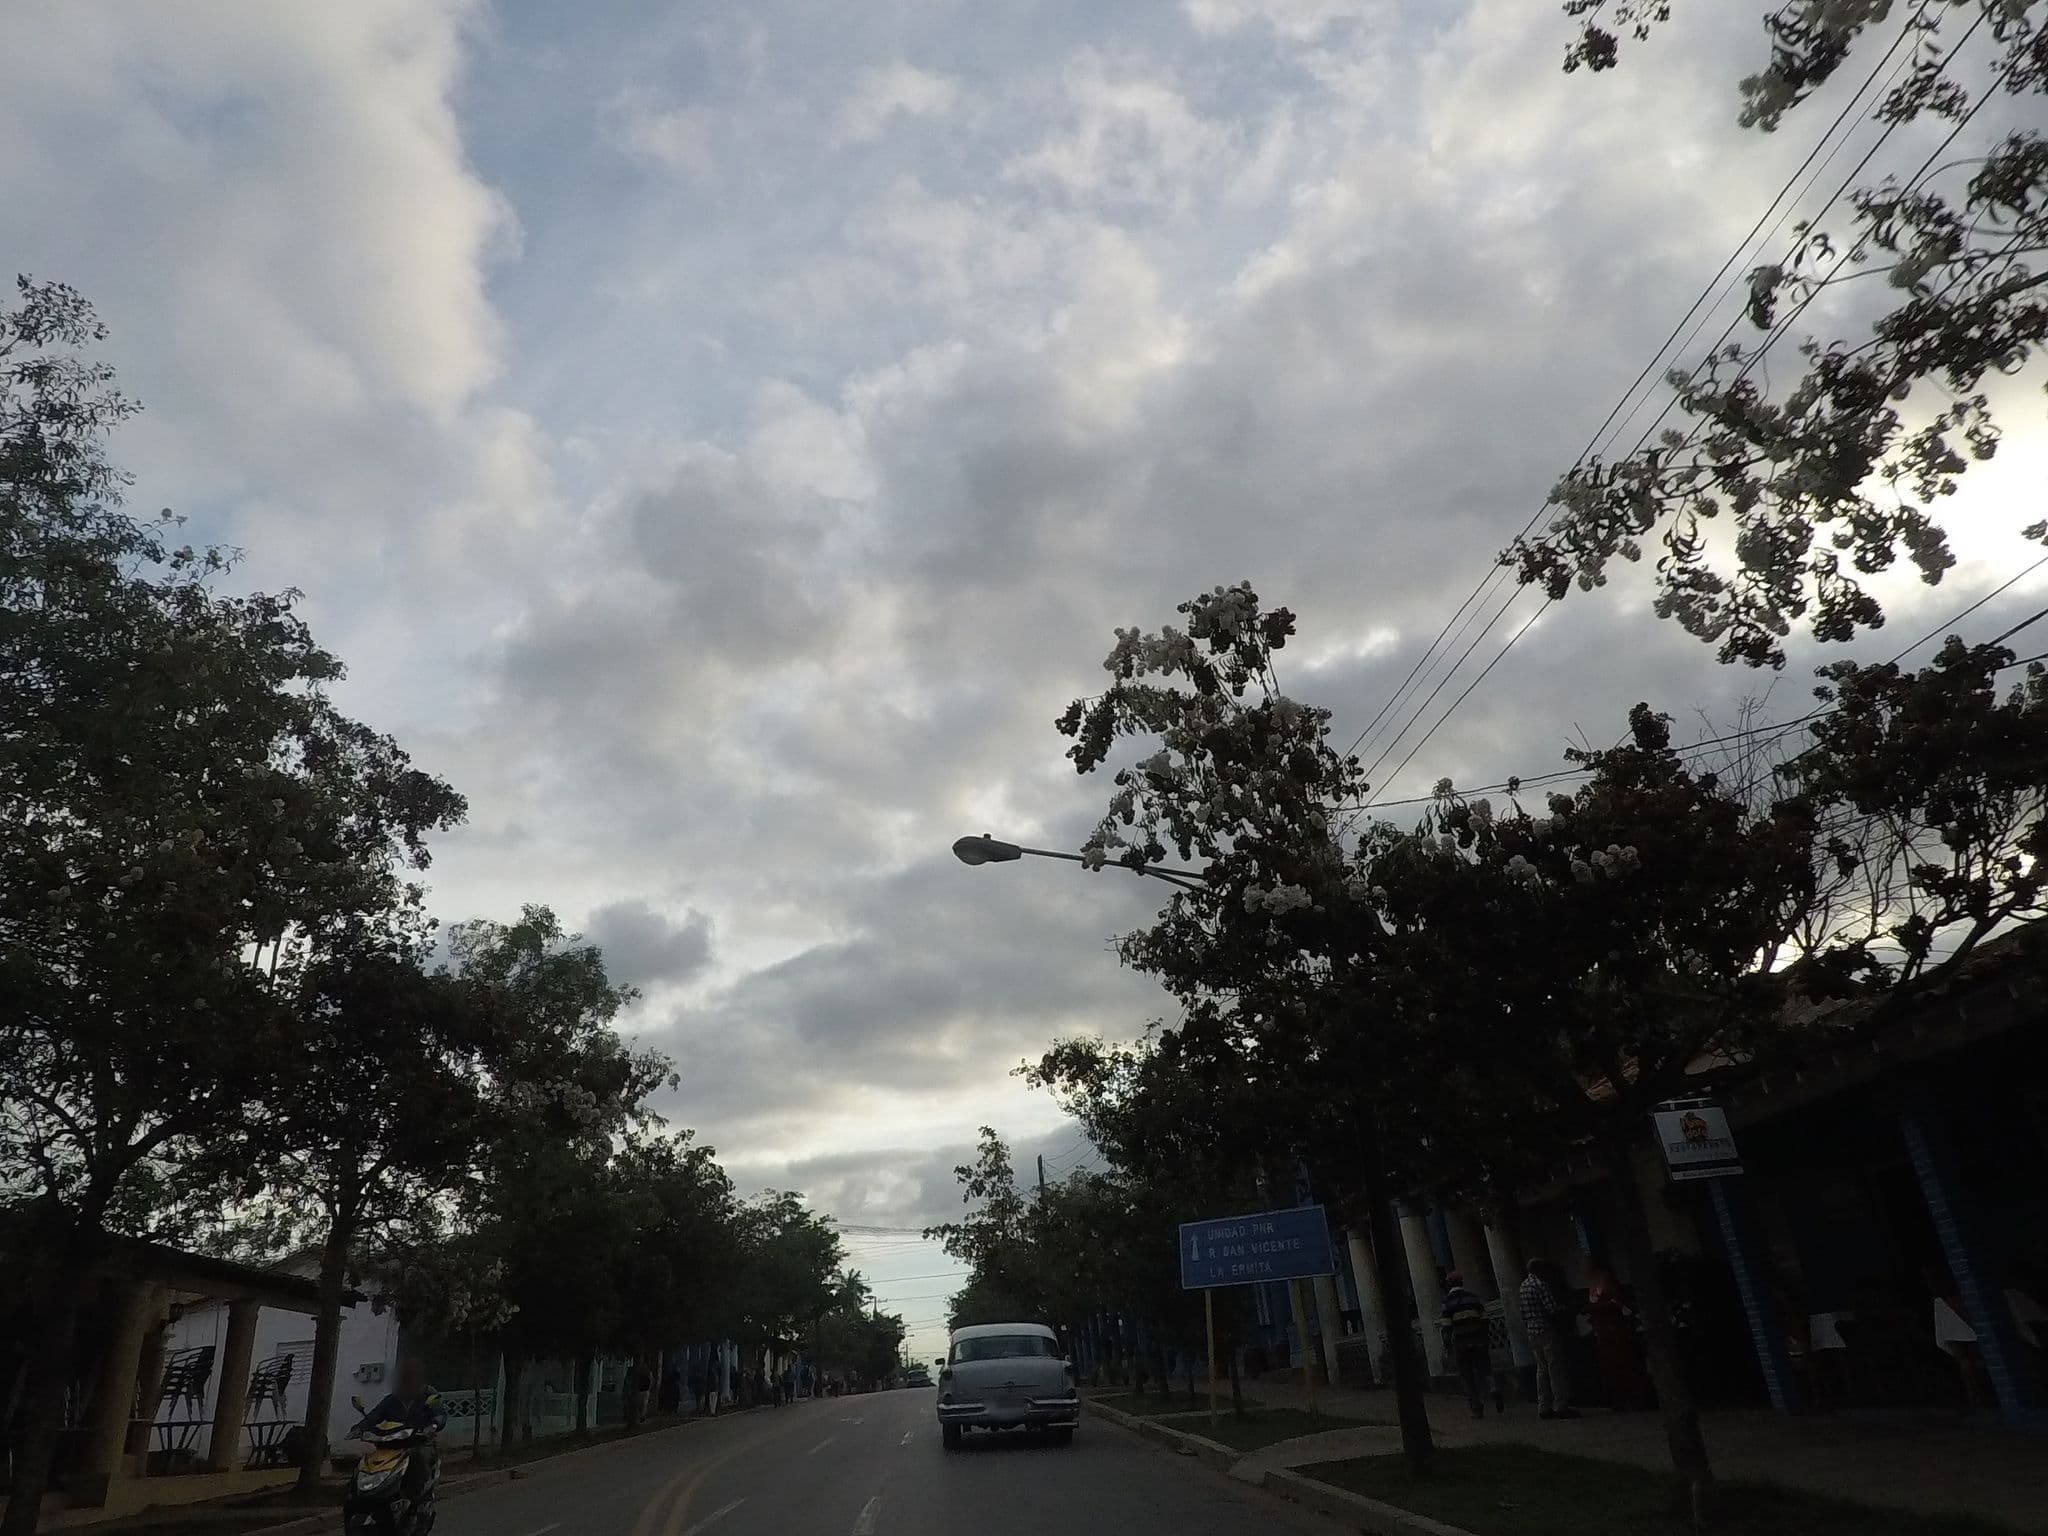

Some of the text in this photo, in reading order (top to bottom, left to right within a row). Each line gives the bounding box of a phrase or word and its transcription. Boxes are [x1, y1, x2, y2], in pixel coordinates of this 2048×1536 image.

[1251, 1238, 1301, 1254] VICENTE
[1210, 1262, 1272, 1278] LA ERMITA
